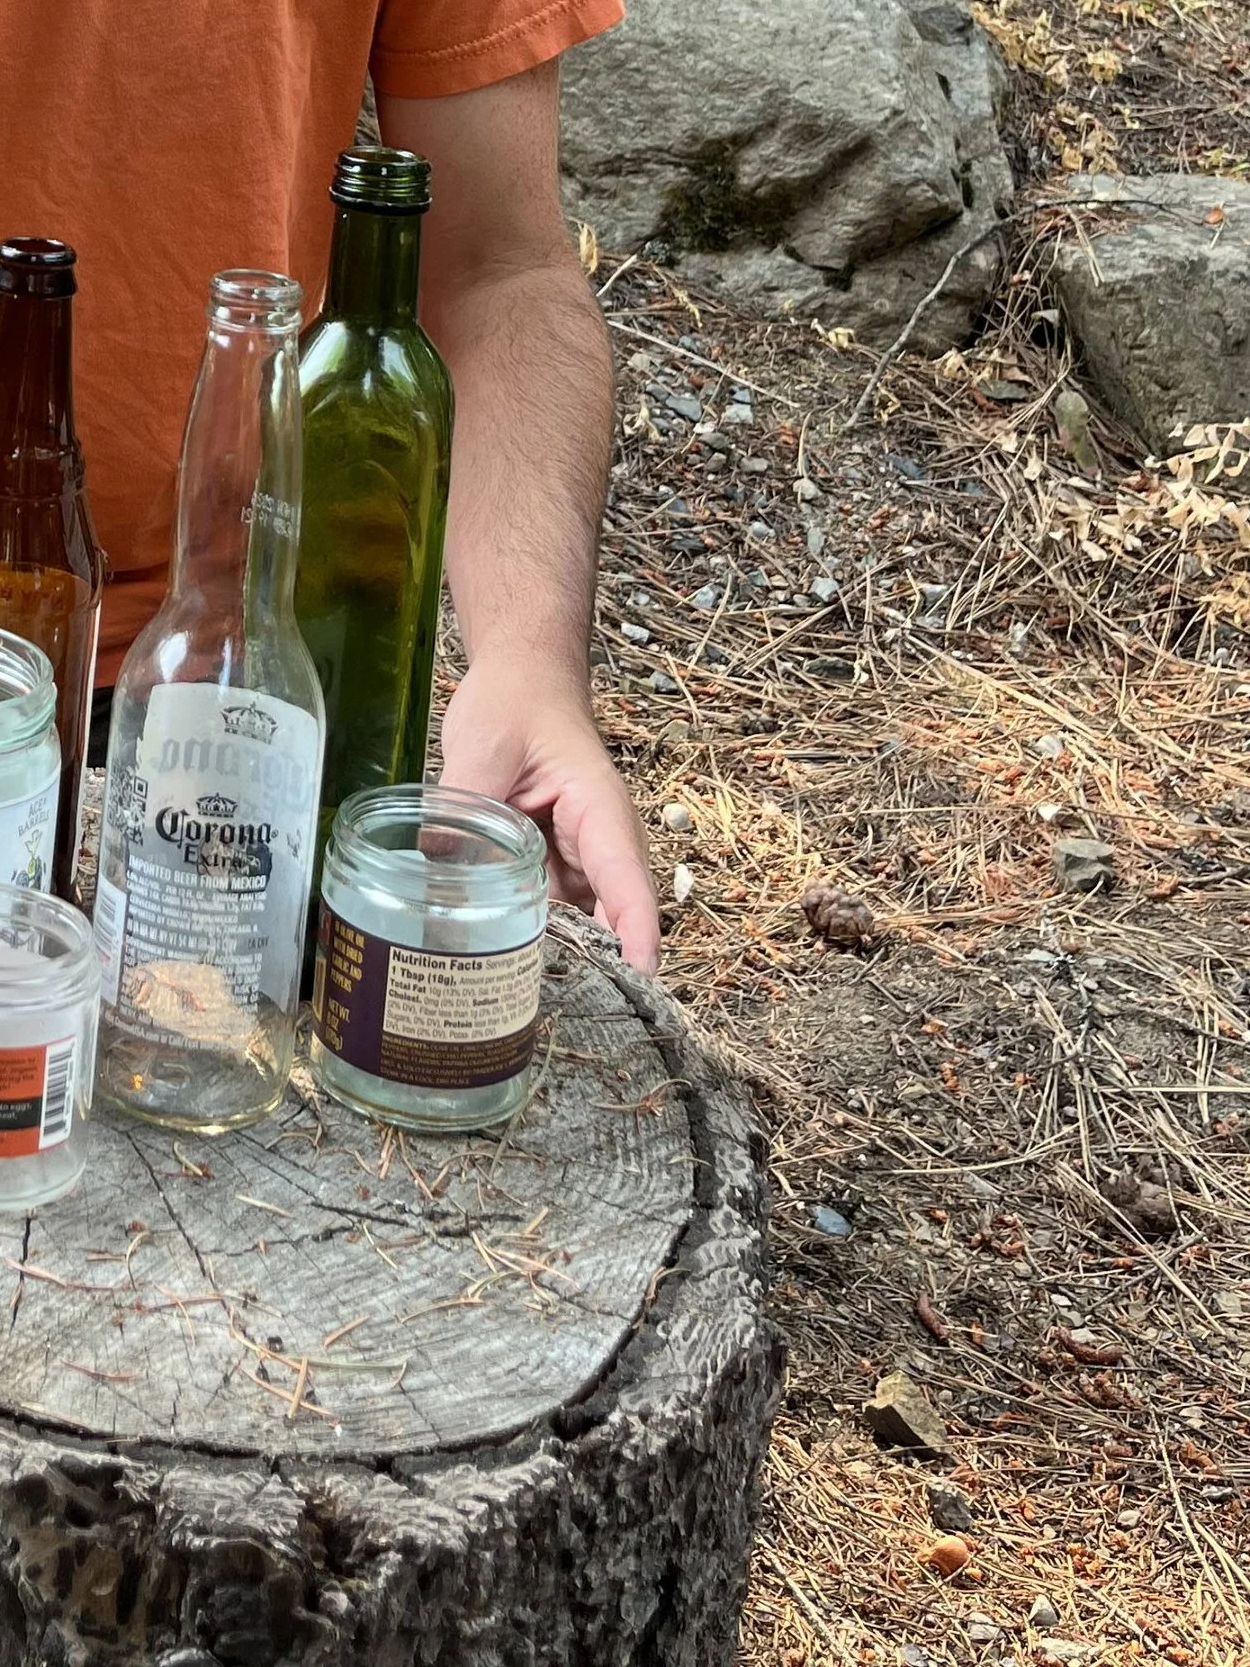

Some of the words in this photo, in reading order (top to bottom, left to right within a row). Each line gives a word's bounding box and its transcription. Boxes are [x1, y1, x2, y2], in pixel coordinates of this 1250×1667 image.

[155, 806, 271, 848] Corona
[183, 842, 243, 869] Extra
[129, 855, 172, 881] IMPORTED
[174, 870, 198, 887] BEER
[200, 874, 228, 889] FROM
[231, 875, 267, 890] MEXICO
[165, 884, 177, 895] PER
[169, 932, 177, 944] VT
[254, 953, 262, 962] TO
[392, 948, 446, 970] Nutrition
[450, 958, 483, 971] Facts
[330, 967, 352, 993] PEPPERS
[350, 963, 363, 981] AND
[391, 965, 396, 975] 1
[400, 967, 425, 983] Tbsp
[427, 972, 457, 987] (18g),
[459, 977, 484, 985] Amount
[485, 976, 495, 985] per
[390, 977, 411, 990] Total
[412, 983, 426, 994] Fat
[429, 986, 442, 997] 10g
[443, 987, 461, 997] (13%
[490, 985, 501, 994] Fat
[329, 996, 338, 1014] NET
[423, 996, 439, 1007] 0mg
[472, 997, 499, 1007] Sodium
[419, 1006, 437, 1016] Fiber
[438, 1008, 452, 1017] less
[453, 1009, 468, 1018] than
[470, 1009, 478, 1019] 1g
[401, 1025, 416, 1035] Iron
[413, 1016, 425, 1025] 0%
[443, 1019, 473, 1028] Protein
[474, 1019, 486, 1028] less
[487, 1017, 500, 1026] than
[0, 1103, 9, 1111] to
